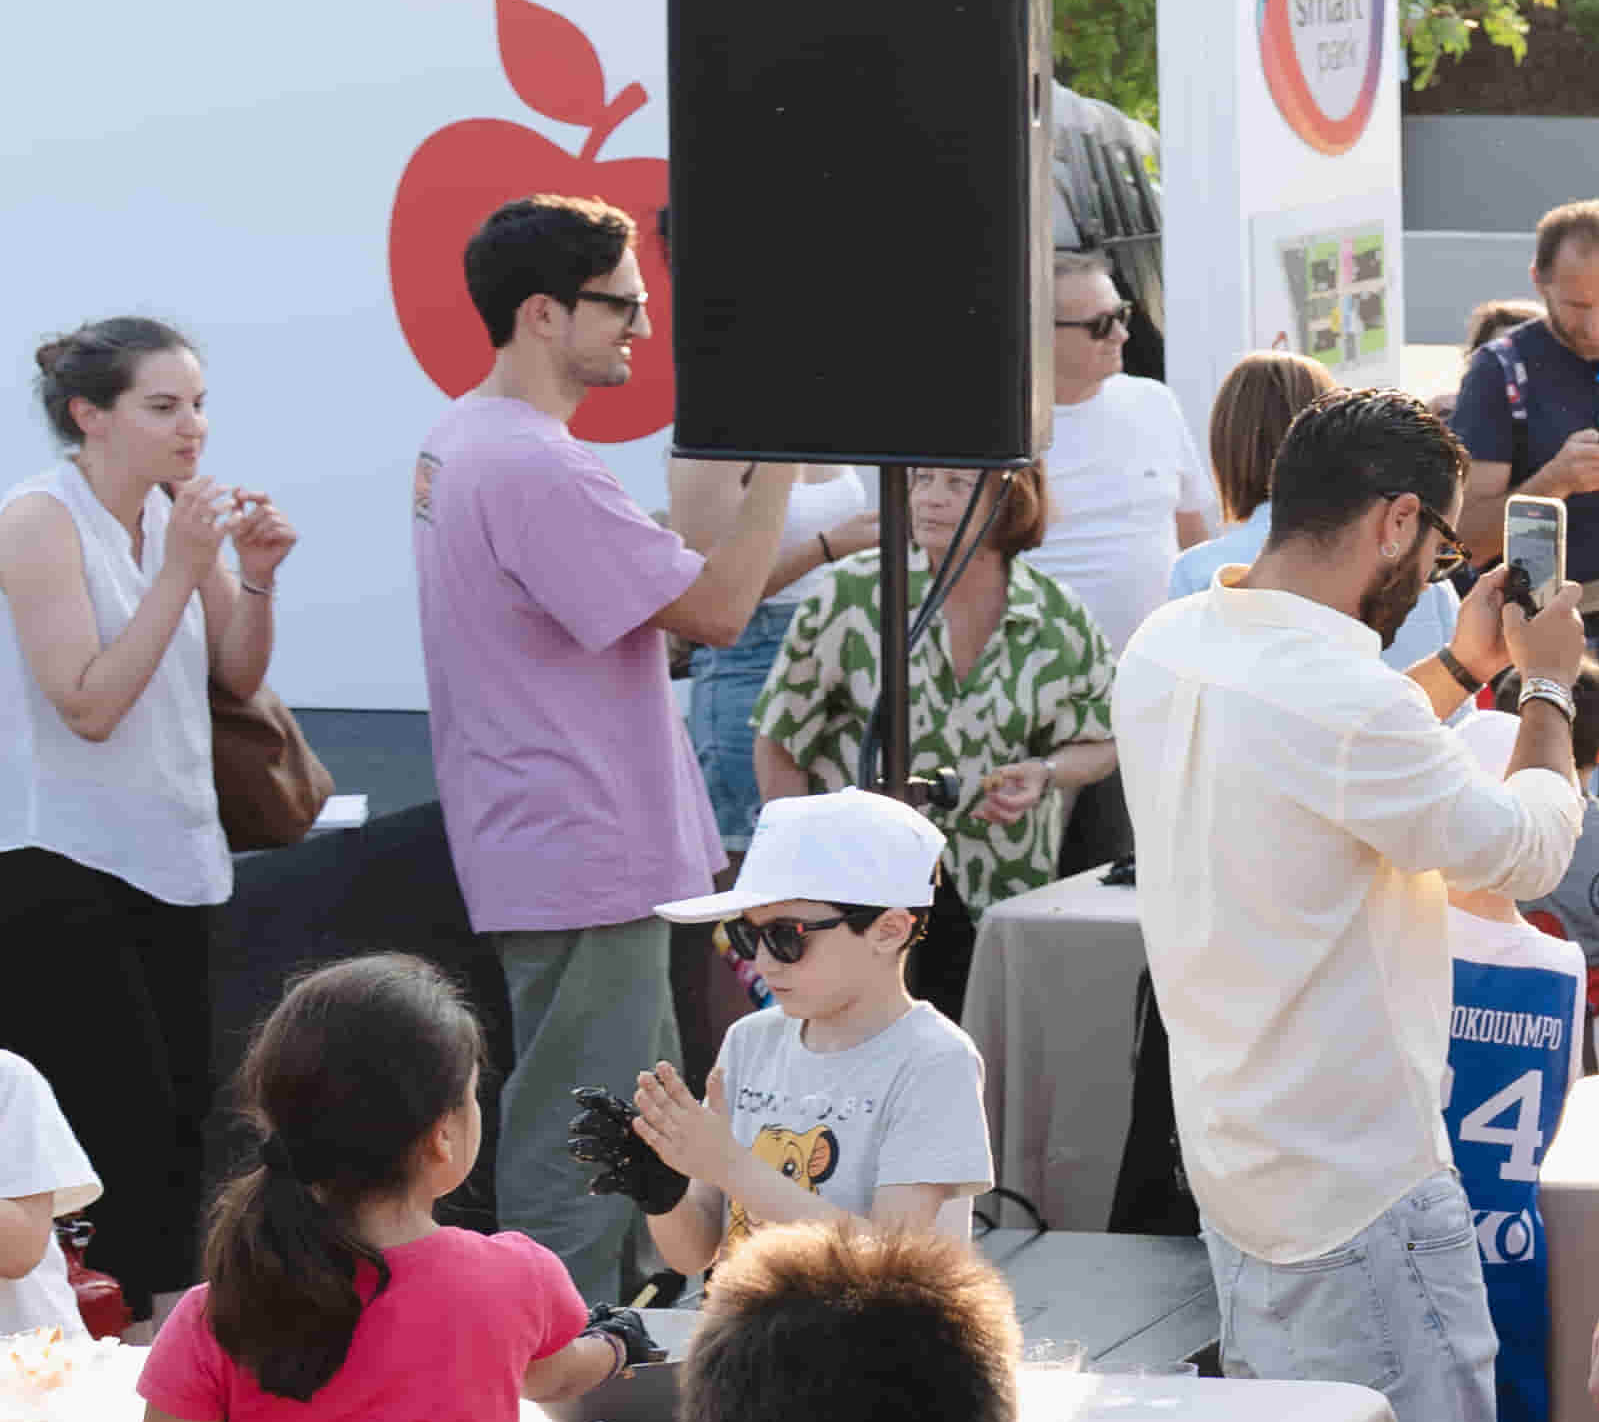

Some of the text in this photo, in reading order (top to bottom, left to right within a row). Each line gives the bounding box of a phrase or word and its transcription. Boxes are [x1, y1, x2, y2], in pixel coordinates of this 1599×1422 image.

[1318, 34, 1358, 75] park
[1449, 1005, 1562, 1050] OKOUNMPO
[1444, 1068, 1544, 1181] 4
